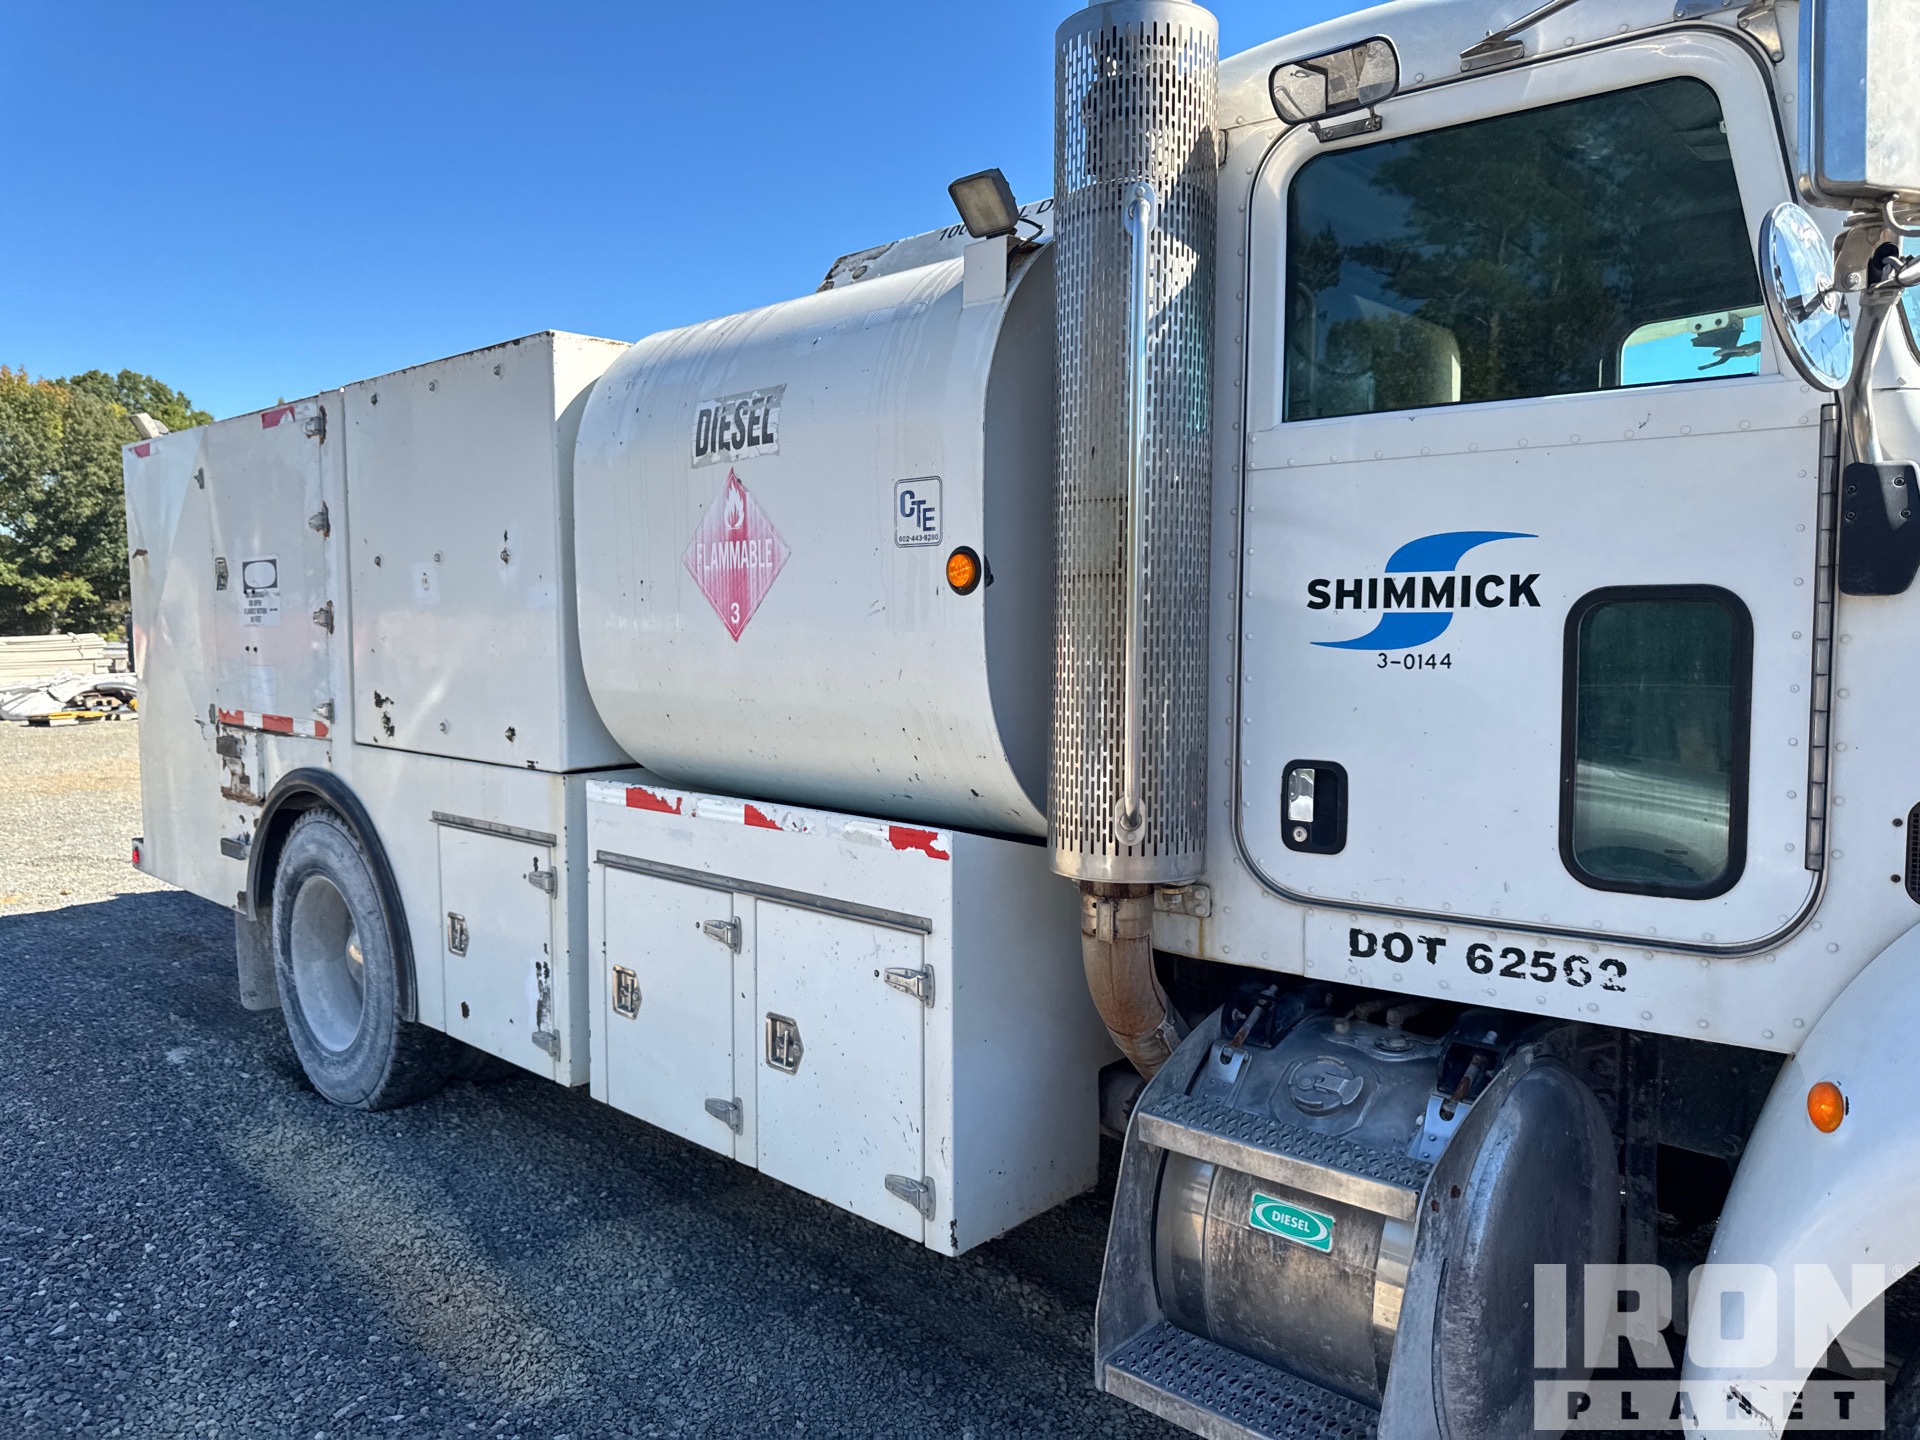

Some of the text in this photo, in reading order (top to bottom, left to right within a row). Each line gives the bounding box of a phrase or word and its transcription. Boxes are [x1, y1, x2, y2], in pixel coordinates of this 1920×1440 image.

[695, 396, 774, 458] DIESEL
[900, 490, 936, 531] CTE
[696, 538, 773, 571] FLAMMABLE
[1306, 574, 1541, 610] SHIMMICK
[731, 602, 741, 624] 3
[1376, 653, 1452, 669] 3-0144
[1349, 928, 1628, 992] DOT 62562
[1271, 1210, 1310, 1233] DIESEL
